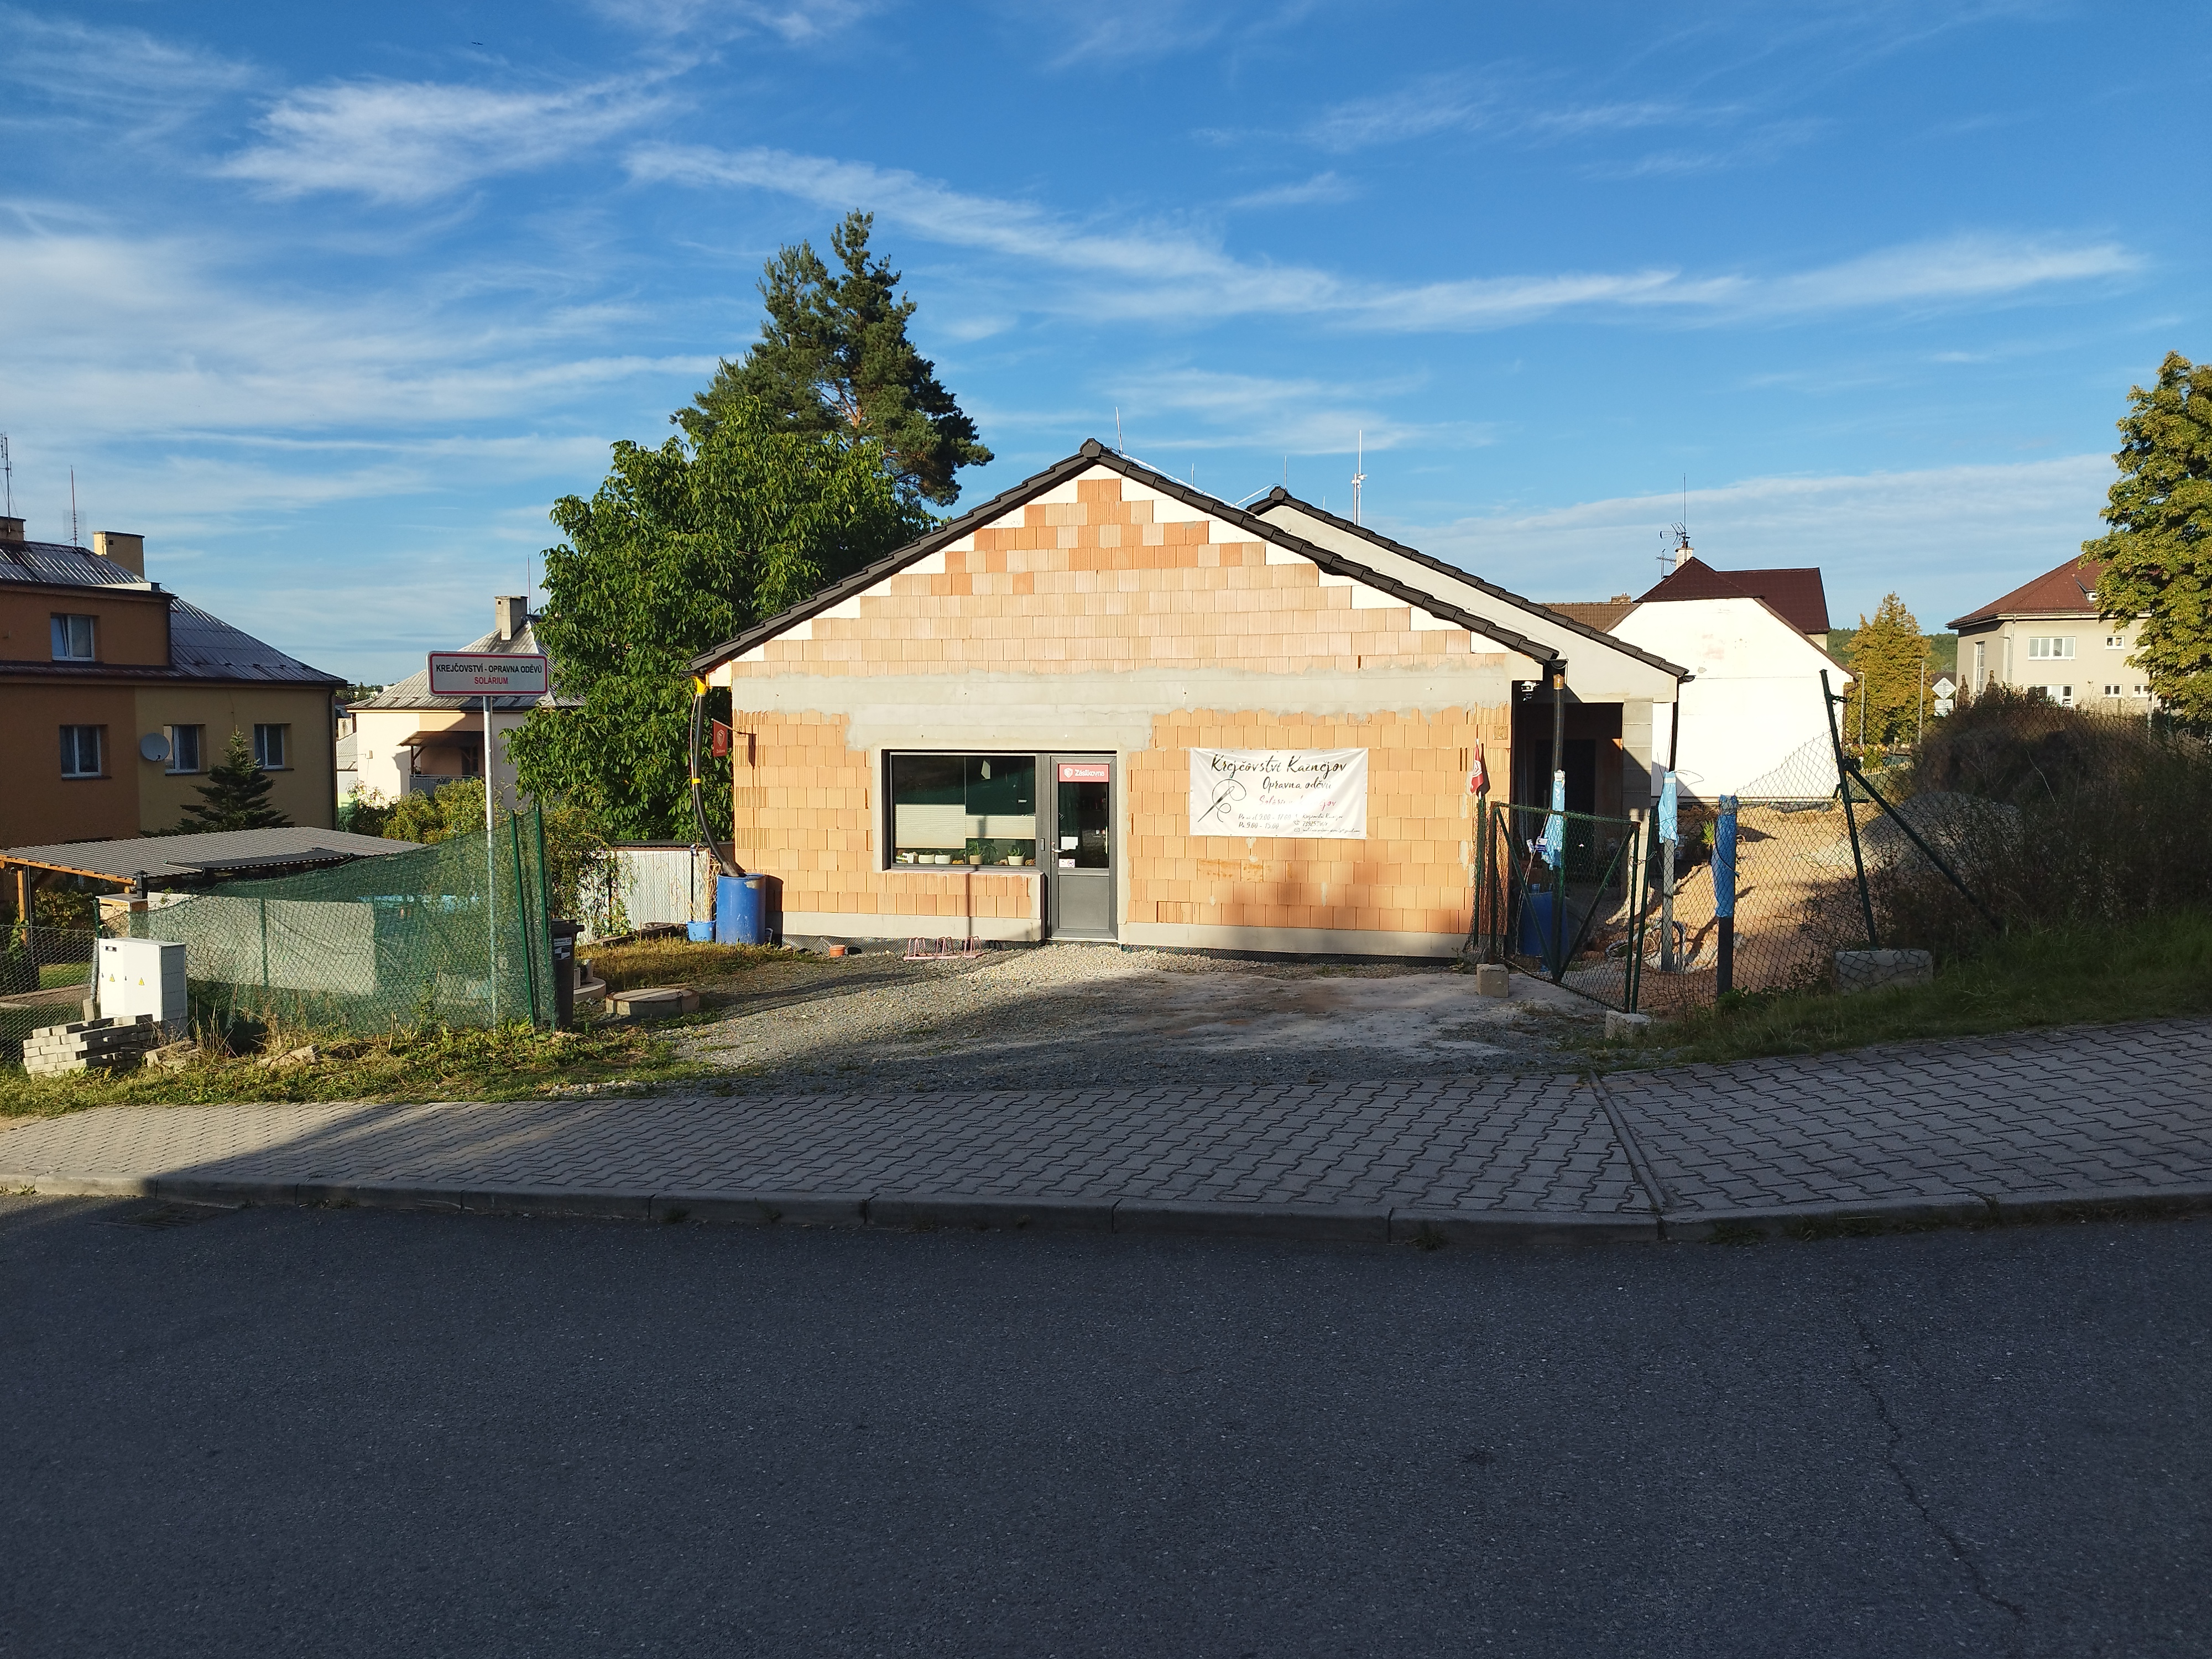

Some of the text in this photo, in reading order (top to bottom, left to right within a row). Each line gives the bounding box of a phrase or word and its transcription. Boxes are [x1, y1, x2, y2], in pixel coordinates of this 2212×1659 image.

[436, 663, 483, 672] KREJČOVSTVÍ
[488, 665, 520, 673] OPRAVNA
[520, 665, 542, 674] ODĚVŮ
[474, 675, 508, 685] SOLÁRIUM
[1211, 754, 1347, 780] Krejčovství Kaznějov
[1074, 768, 1105, 778] Zásilkovna
[1262, 776, 1302, 794] Opravna
[1259, 795, 1293, 806] Solári
